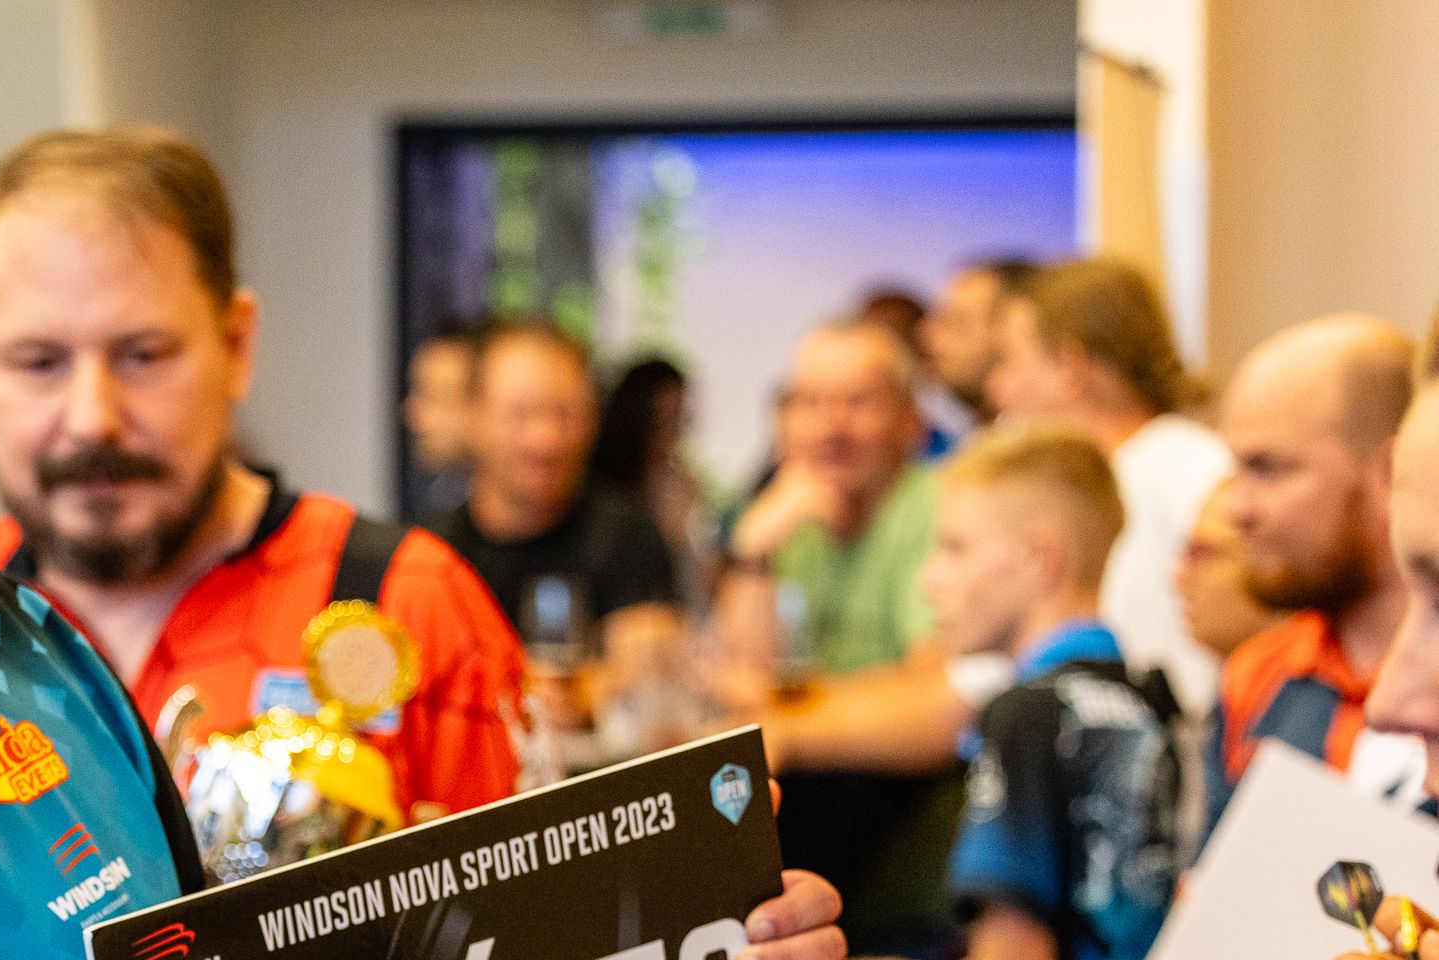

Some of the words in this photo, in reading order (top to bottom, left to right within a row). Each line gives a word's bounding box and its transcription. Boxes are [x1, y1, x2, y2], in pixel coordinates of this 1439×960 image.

[46, 855, 132, 922] WINDSN
[258, 879, 386, 952] WINDSON
[388, 857, 460, 913] NOVA
[460, 831, 540, 891] SPORT
[543, 811, 610, 866] OPEN
[611, 792, 677, 846] 2023
